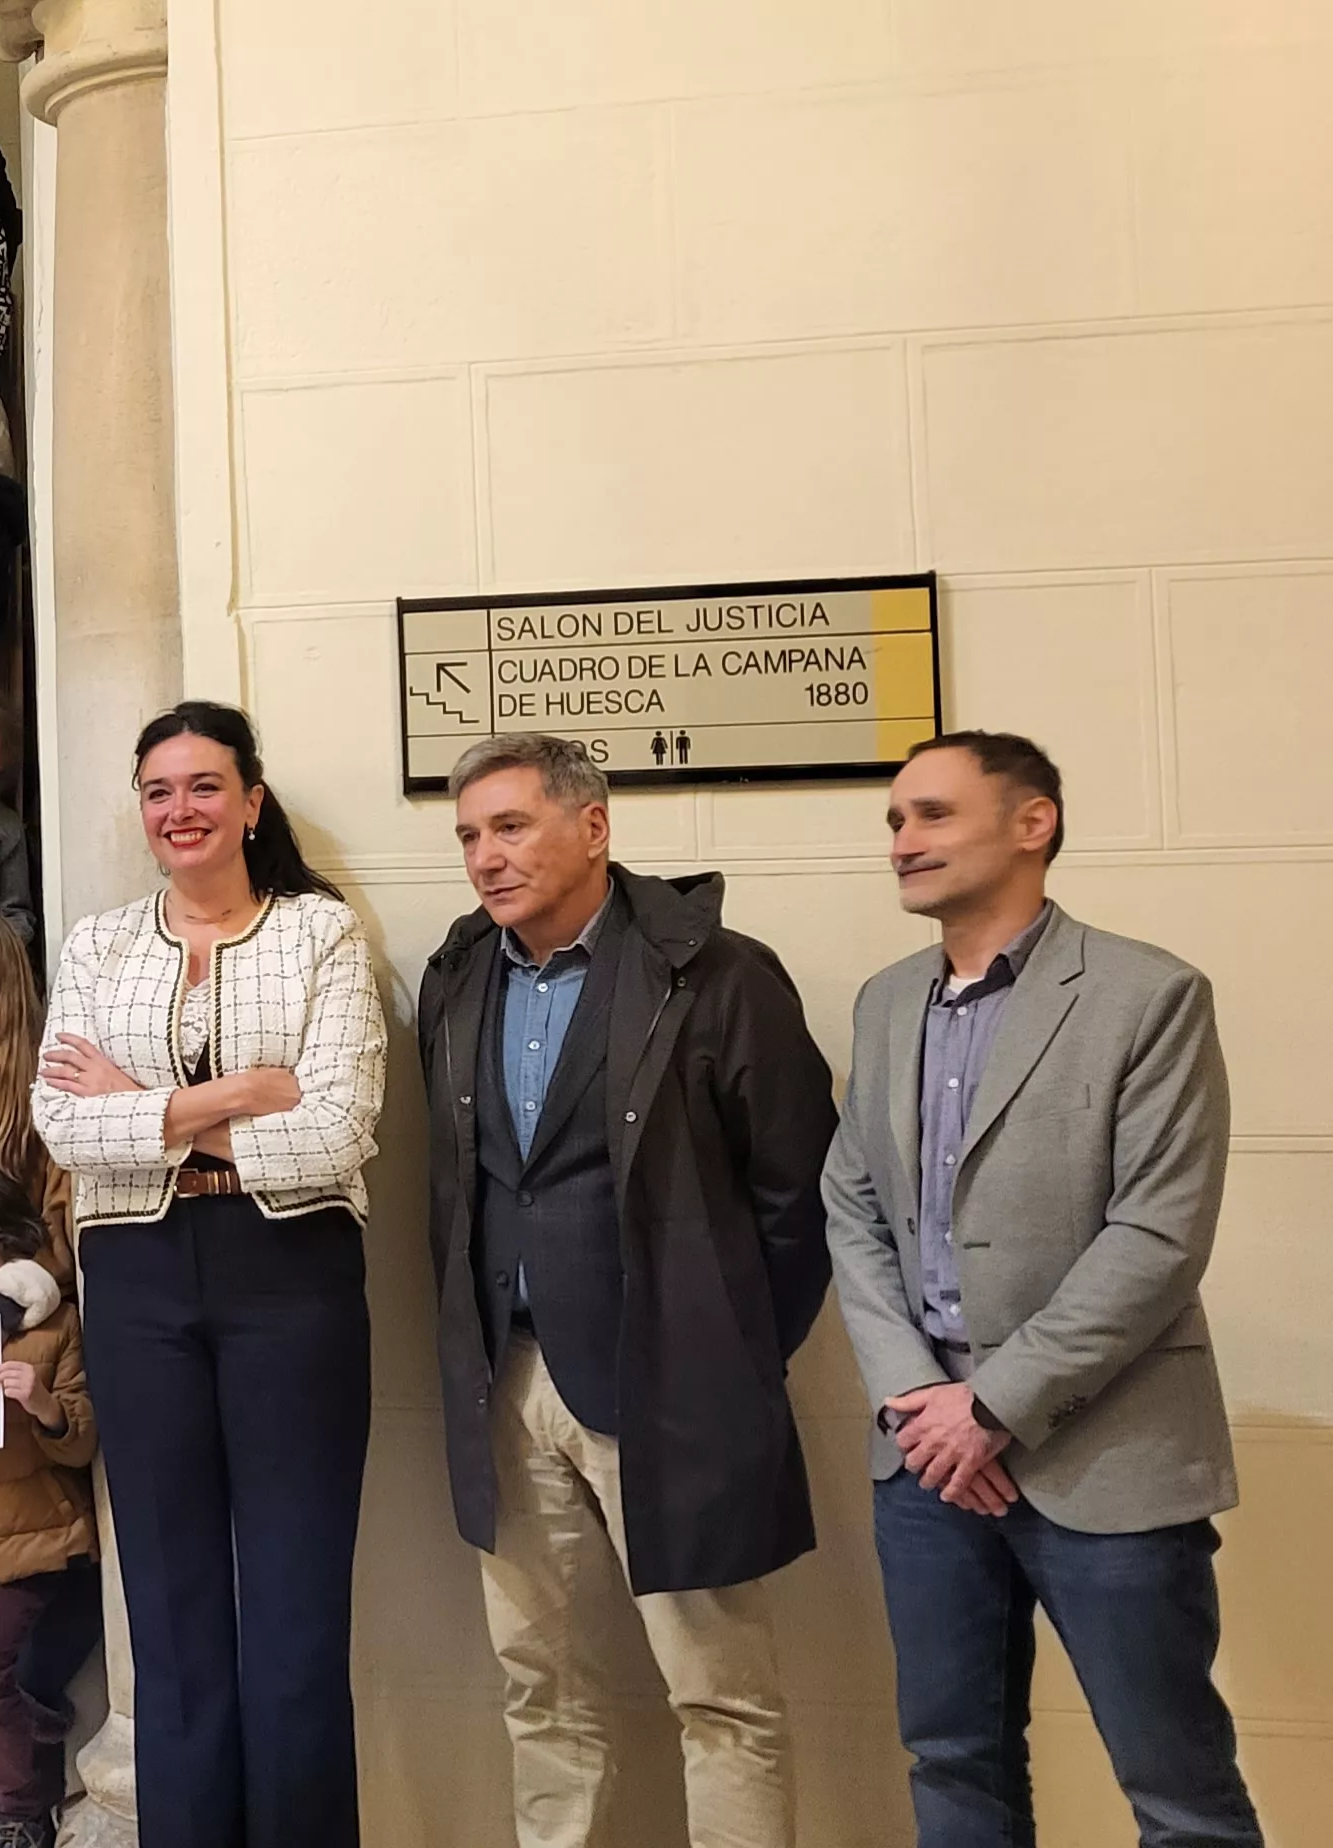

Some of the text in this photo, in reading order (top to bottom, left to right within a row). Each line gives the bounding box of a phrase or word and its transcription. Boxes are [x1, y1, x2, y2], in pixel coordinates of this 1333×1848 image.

[496, 602, 830, 641] SALON DEL JUSTICIA
[497, 646, 867, 684] CUADRO DE LA CAMPANA
[498, 681, 869, 717] DE HUESCA 1880
